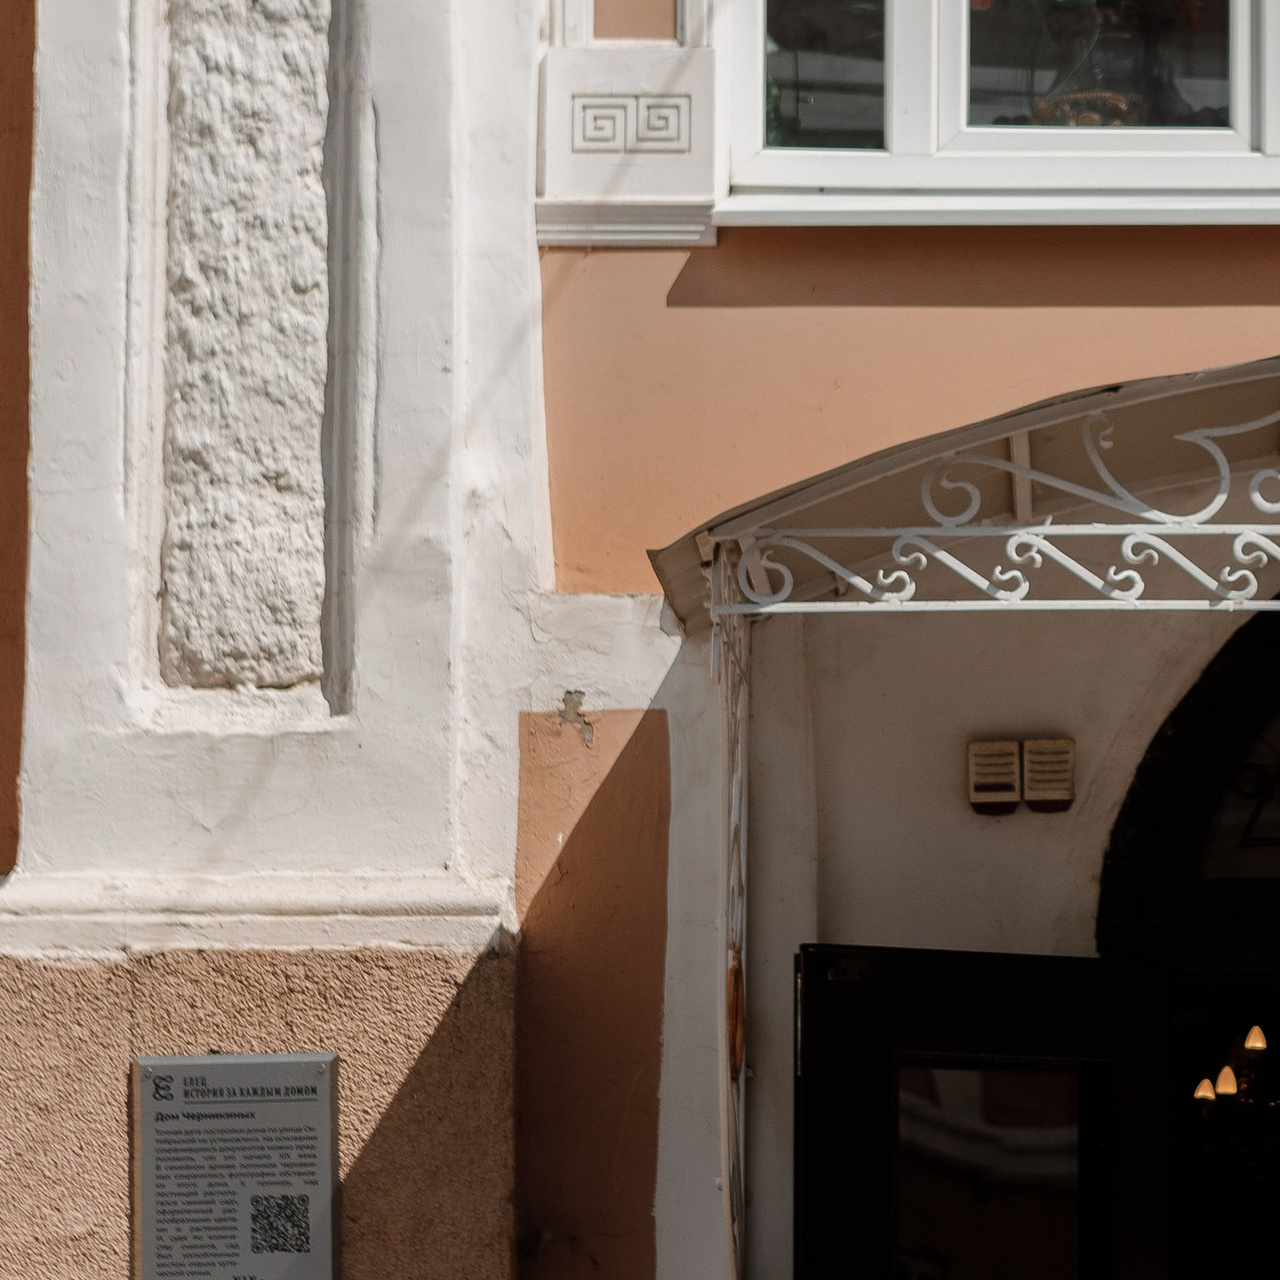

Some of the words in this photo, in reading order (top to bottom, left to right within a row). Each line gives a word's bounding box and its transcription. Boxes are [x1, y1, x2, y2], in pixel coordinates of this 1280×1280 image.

[183, 1088, 225, 1099] ИСТОРИЯ
[226, 1088, 238, 1098] ЗА
[239, 1086, 282, 1098] КАЖДЫМ
[283, 1085, 318, 1097] ДОМОМ
[154, 1111, 179, 1123] Дом
[181, 1111, 256, 1122] Черникиных
